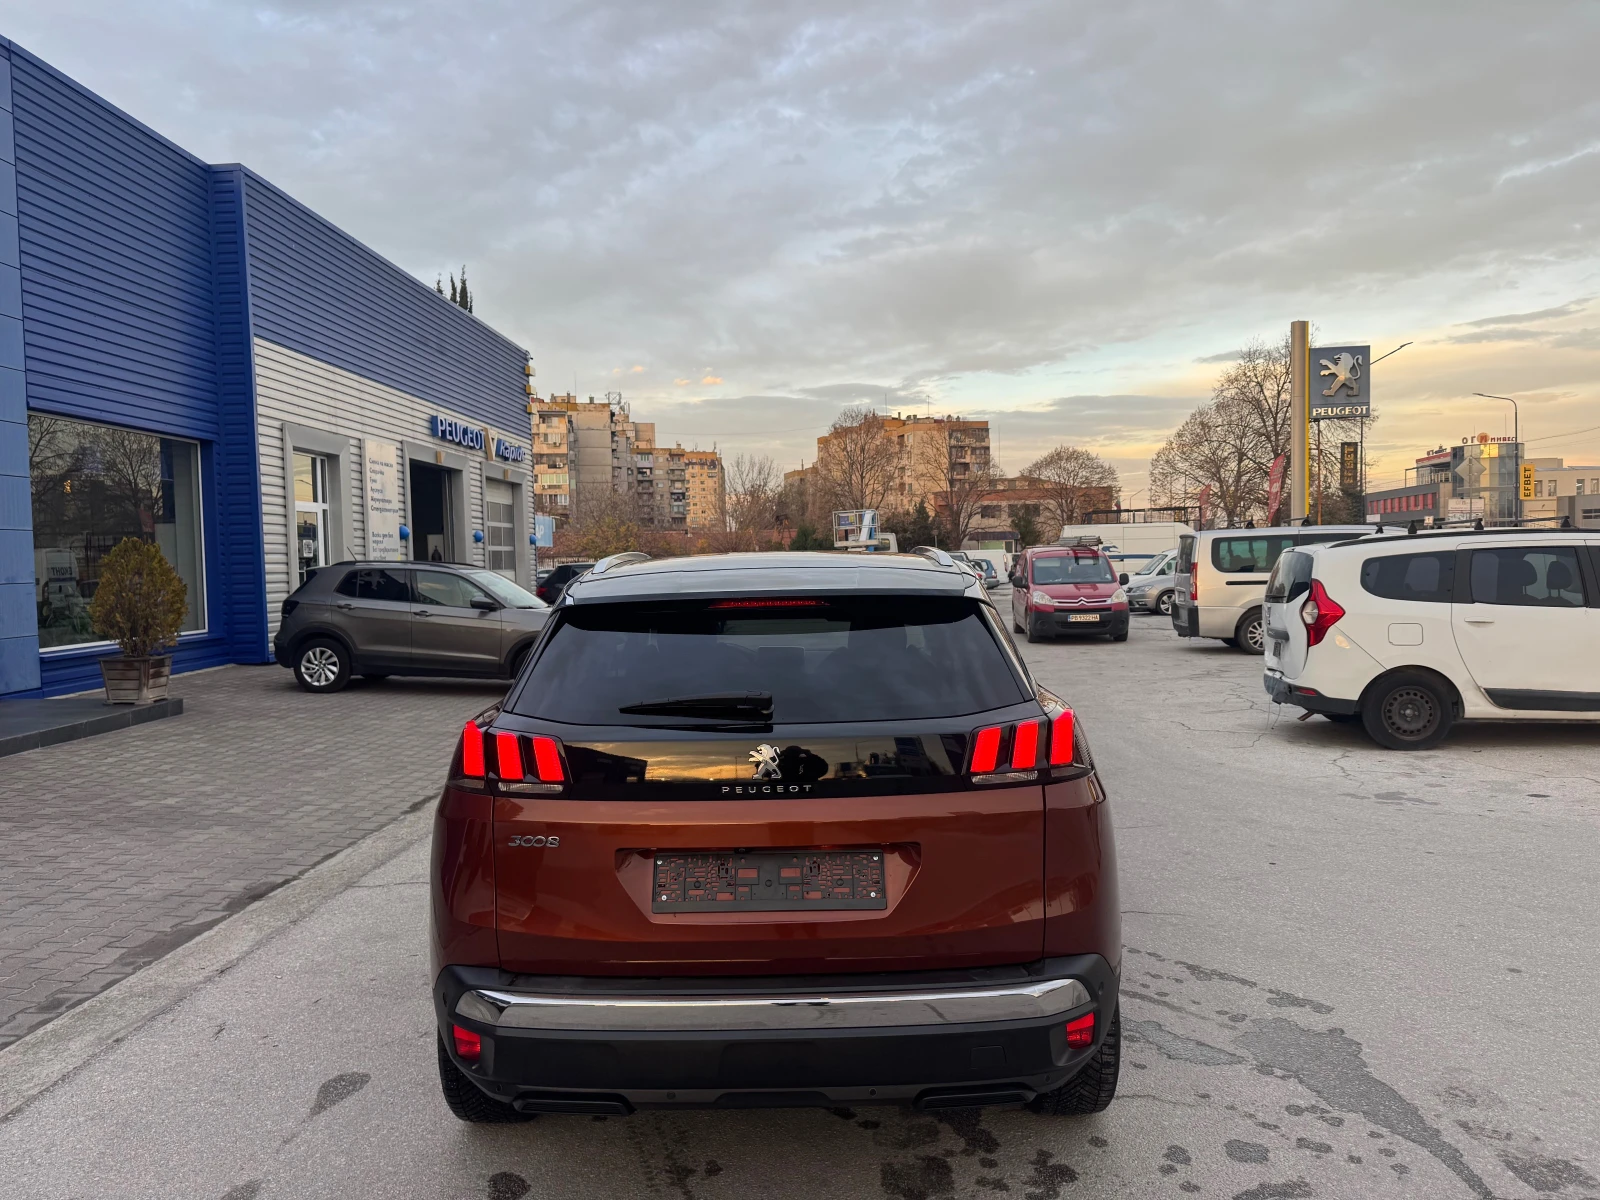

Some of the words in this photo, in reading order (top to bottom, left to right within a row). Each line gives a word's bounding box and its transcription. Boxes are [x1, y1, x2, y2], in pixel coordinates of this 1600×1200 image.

[1312, 405, 1369, 417] PEUGEOT
[437, 415, 485, 450] PEUGEOT
[500, 439, 526, 462] Rapide
[1523, 467, 1531, 498] EFBET
[721, 784, 812, 794] PEUGEOT
[508, 835, 560, 848] 3008
